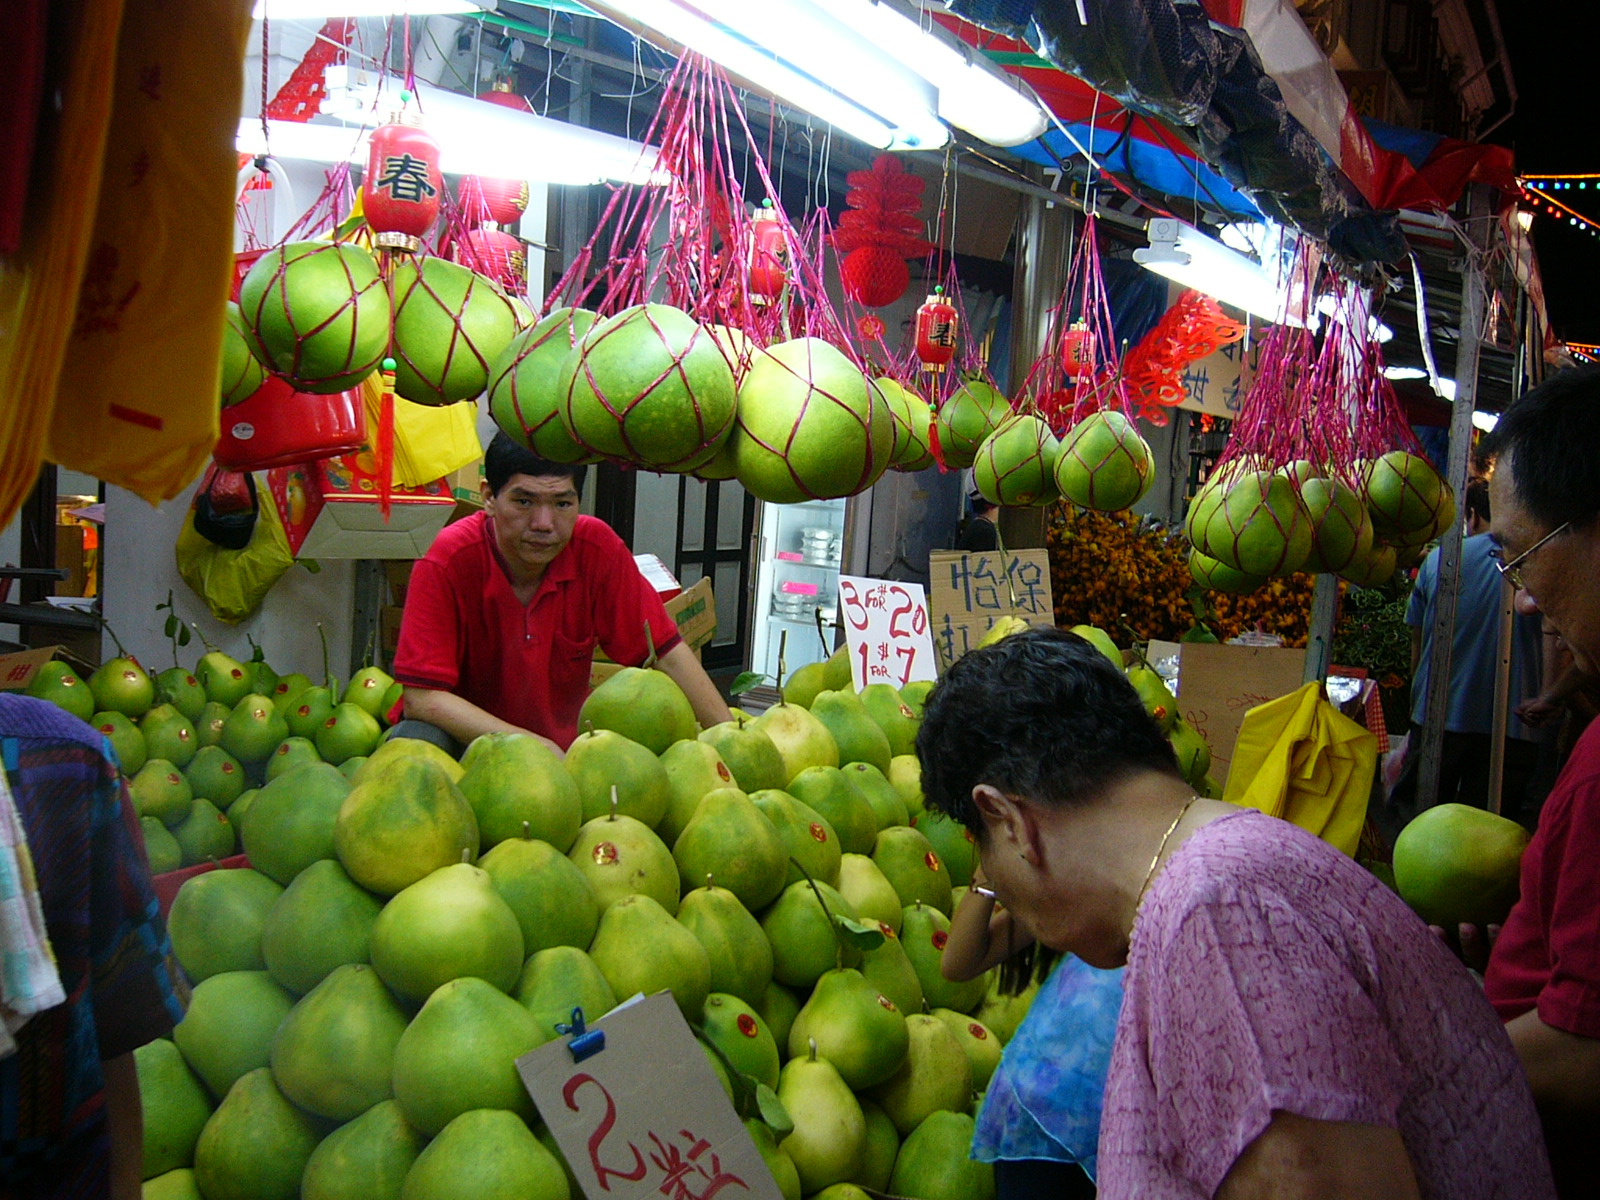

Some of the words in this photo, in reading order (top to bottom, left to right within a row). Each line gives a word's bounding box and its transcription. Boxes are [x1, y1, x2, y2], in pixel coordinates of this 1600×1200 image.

[377, 153, 436, 203] 春
[930, 322, 956, 348] 春
[841, 581, 869, 631] 3
[865, 588, 887, 612] FOR
[951, 555, 1047, 614] 怡保
[858, 642, 868, 687] 1
[870, 665, 891, 678] FOR
